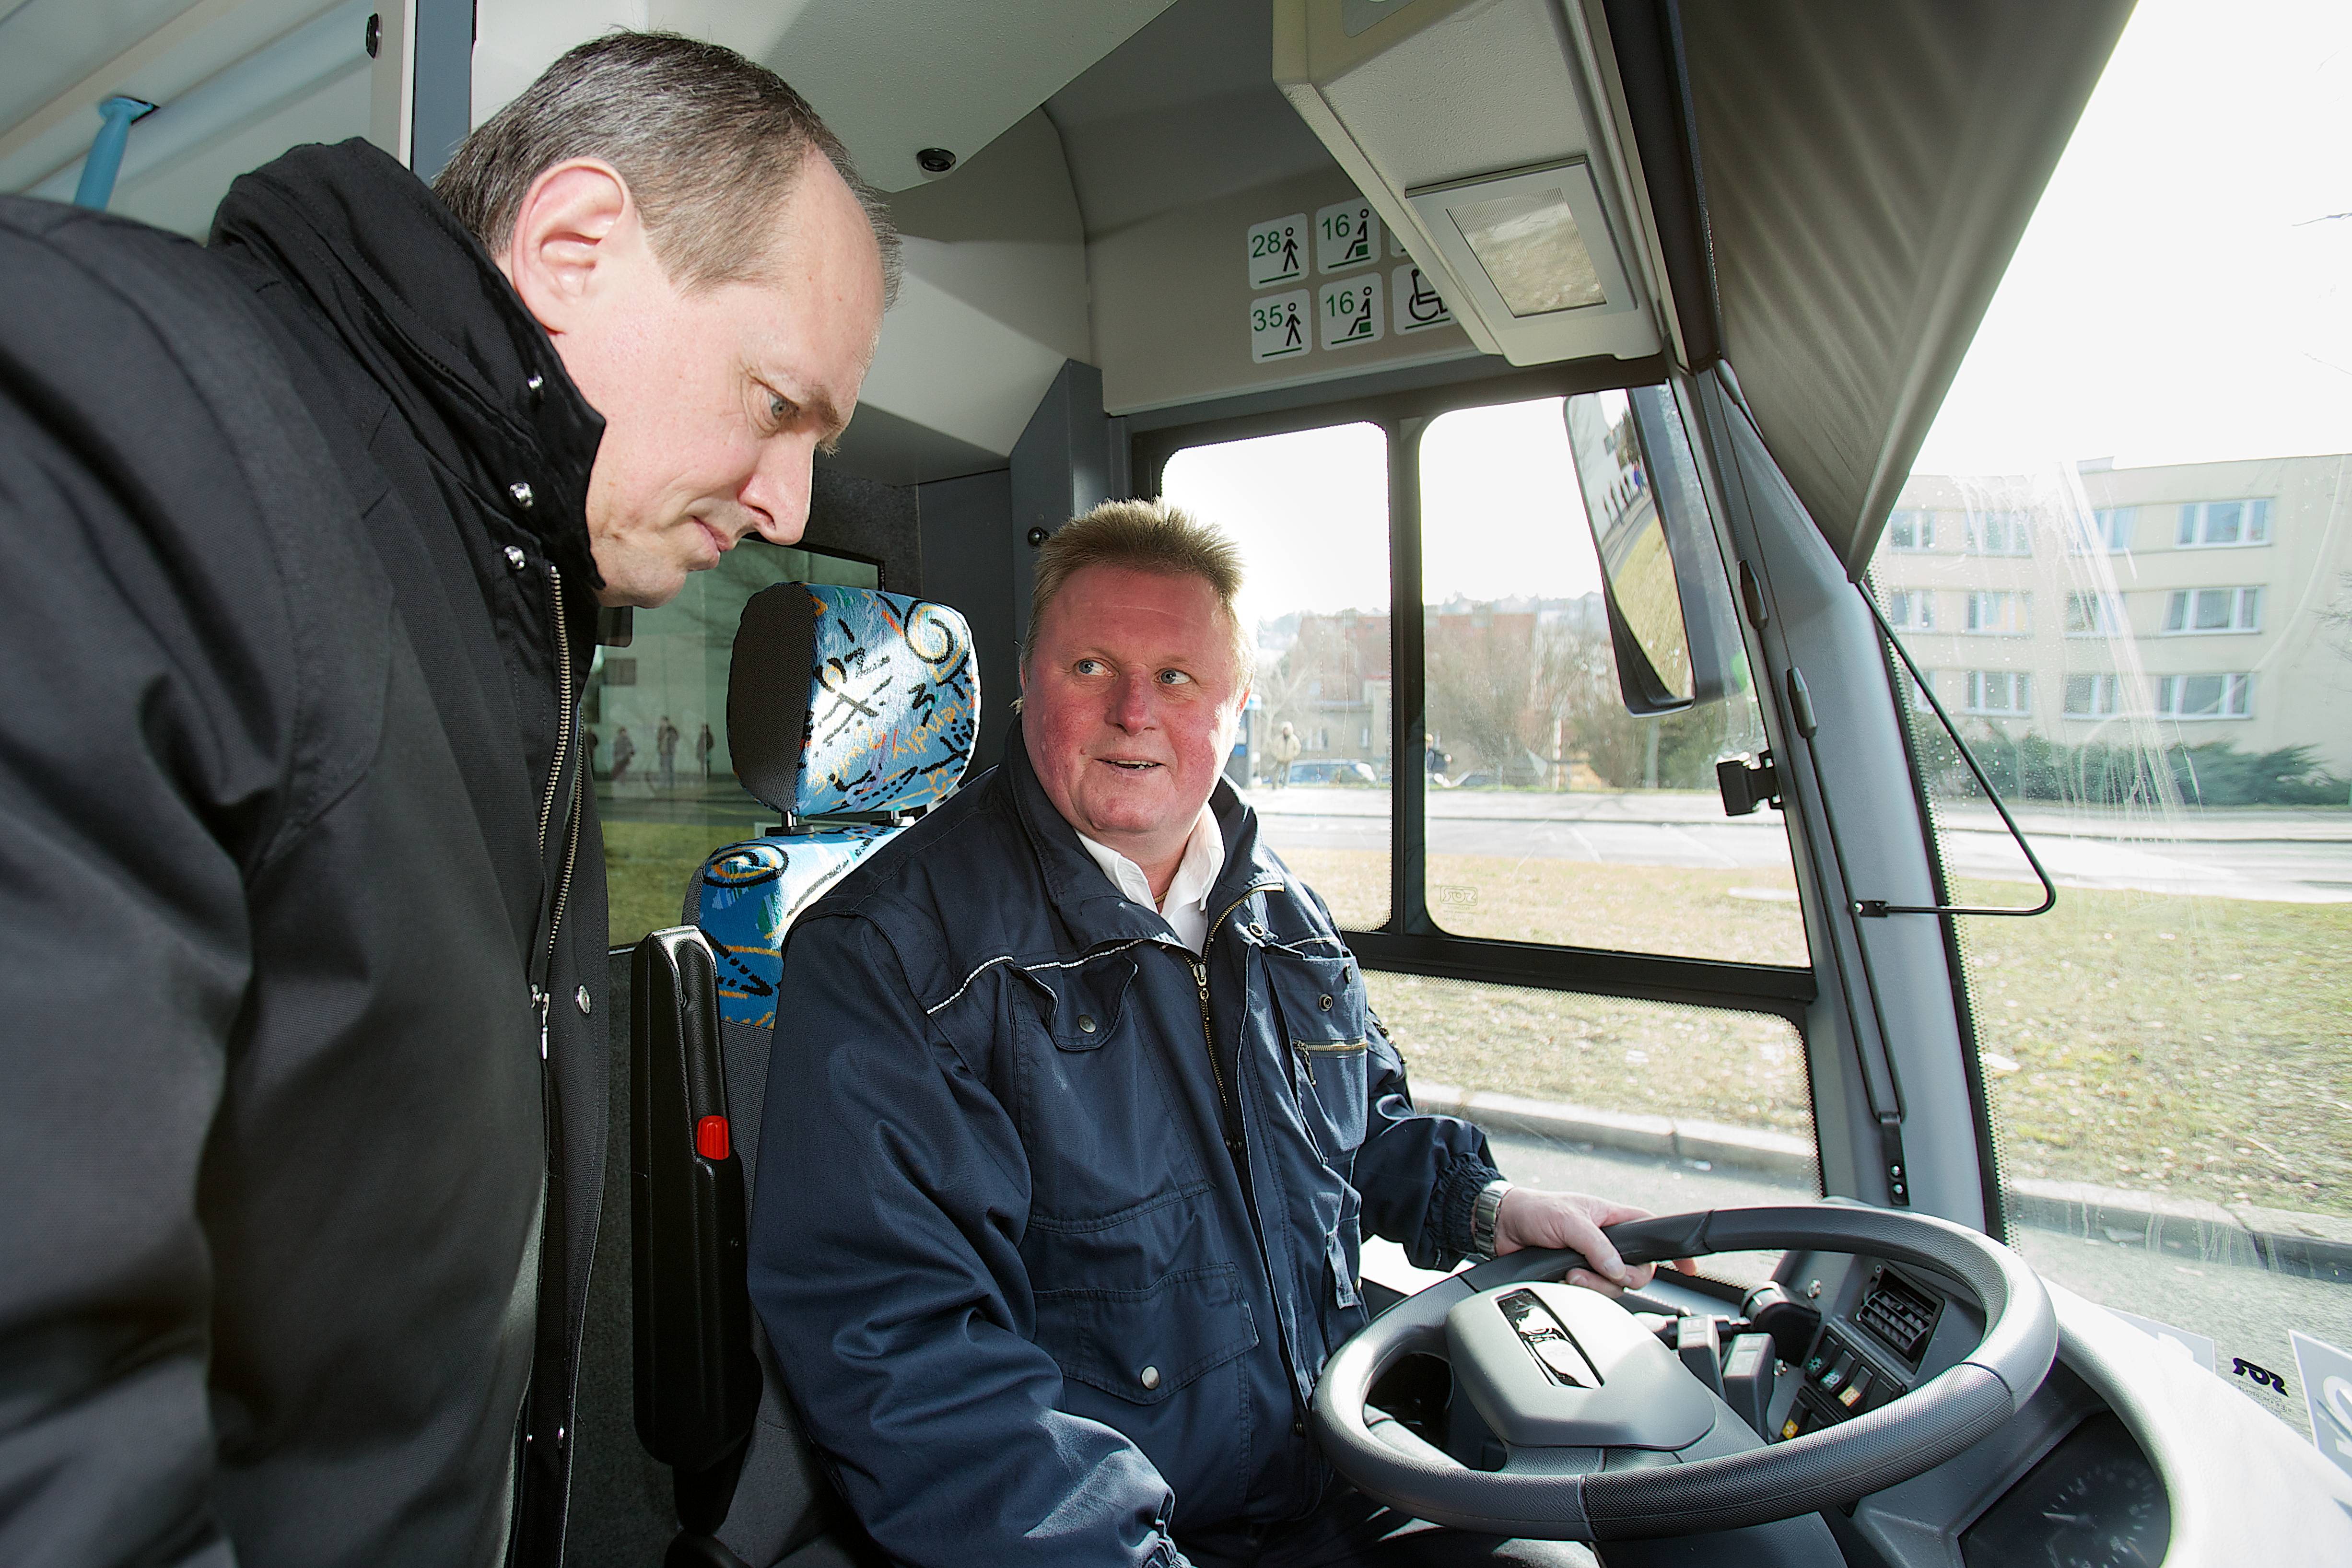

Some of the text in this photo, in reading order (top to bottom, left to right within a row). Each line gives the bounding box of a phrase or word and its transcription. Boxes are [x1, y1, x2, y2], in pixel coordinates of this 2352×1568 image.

[1322, 213, 1350, 240] 16
[1252, 231, 1281, 258] 28
[1326, 291, 1355, 316] 16
[1252, 304, 1283, 332] 35
